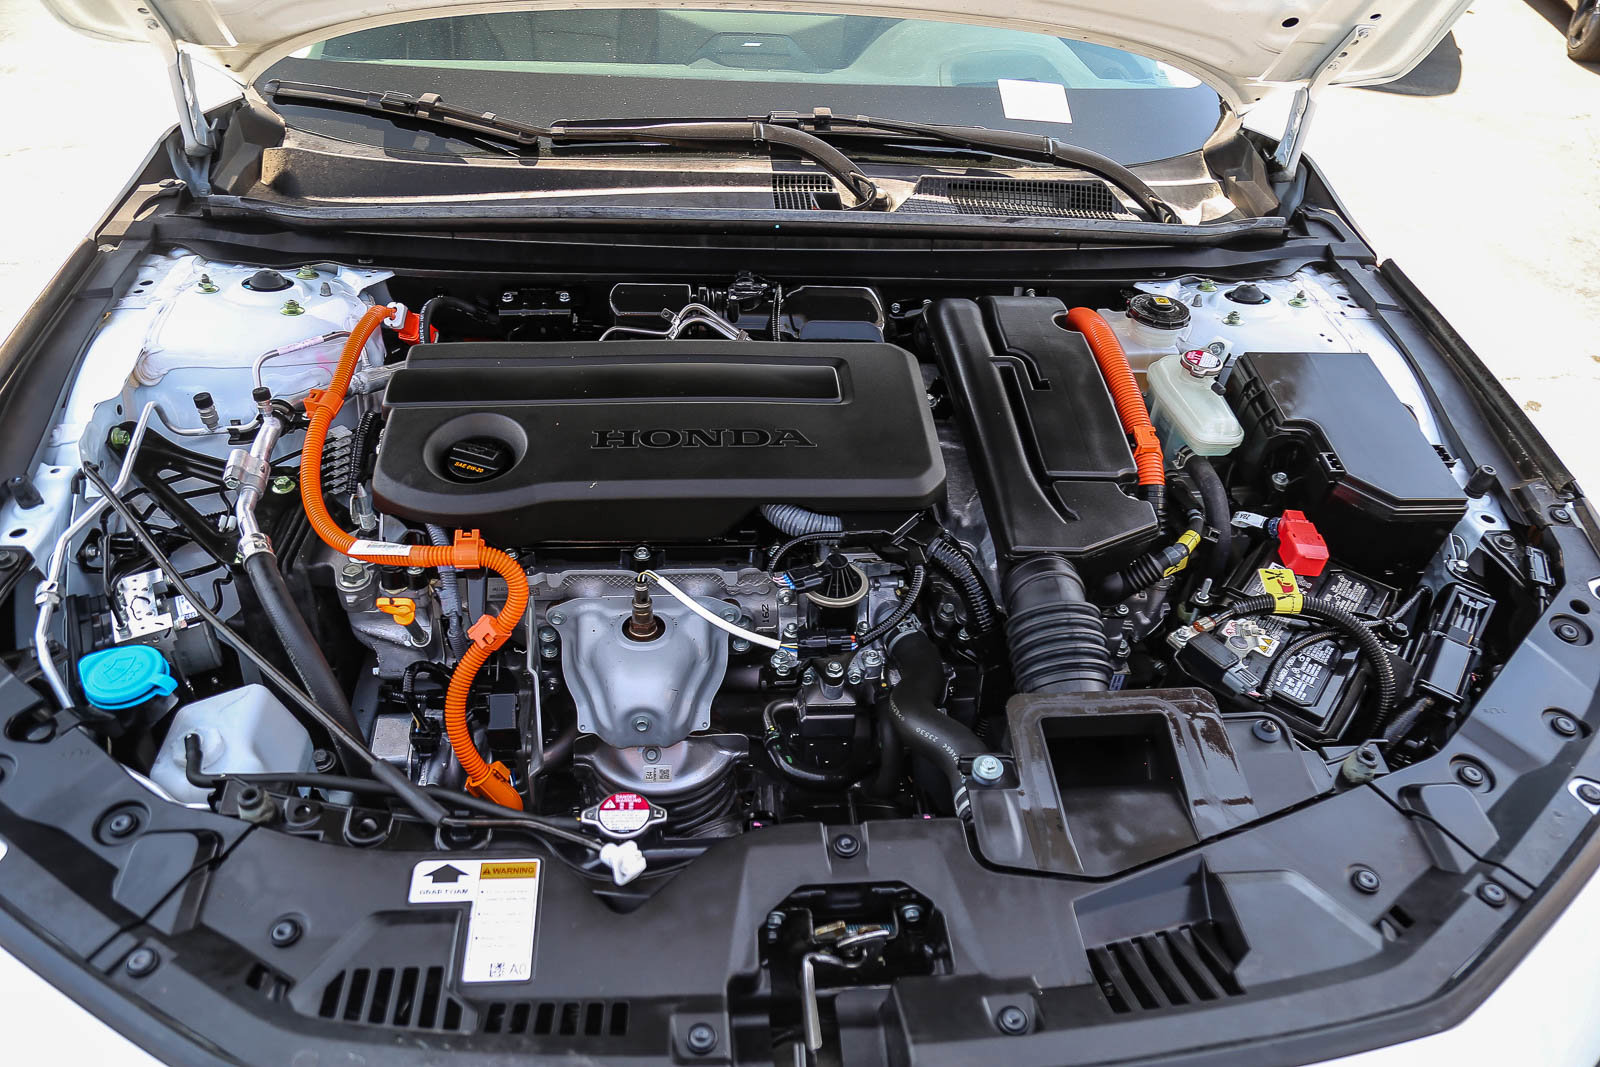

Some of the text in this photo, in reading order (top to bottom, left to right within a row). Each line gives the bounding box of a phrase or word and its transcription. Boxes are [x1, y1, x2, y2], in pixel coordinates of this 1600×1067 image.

[590, 428, 818, 449] HONDA
[915, 727, 939, 743] 23530
[492, 866, 535, 875] WARNING
